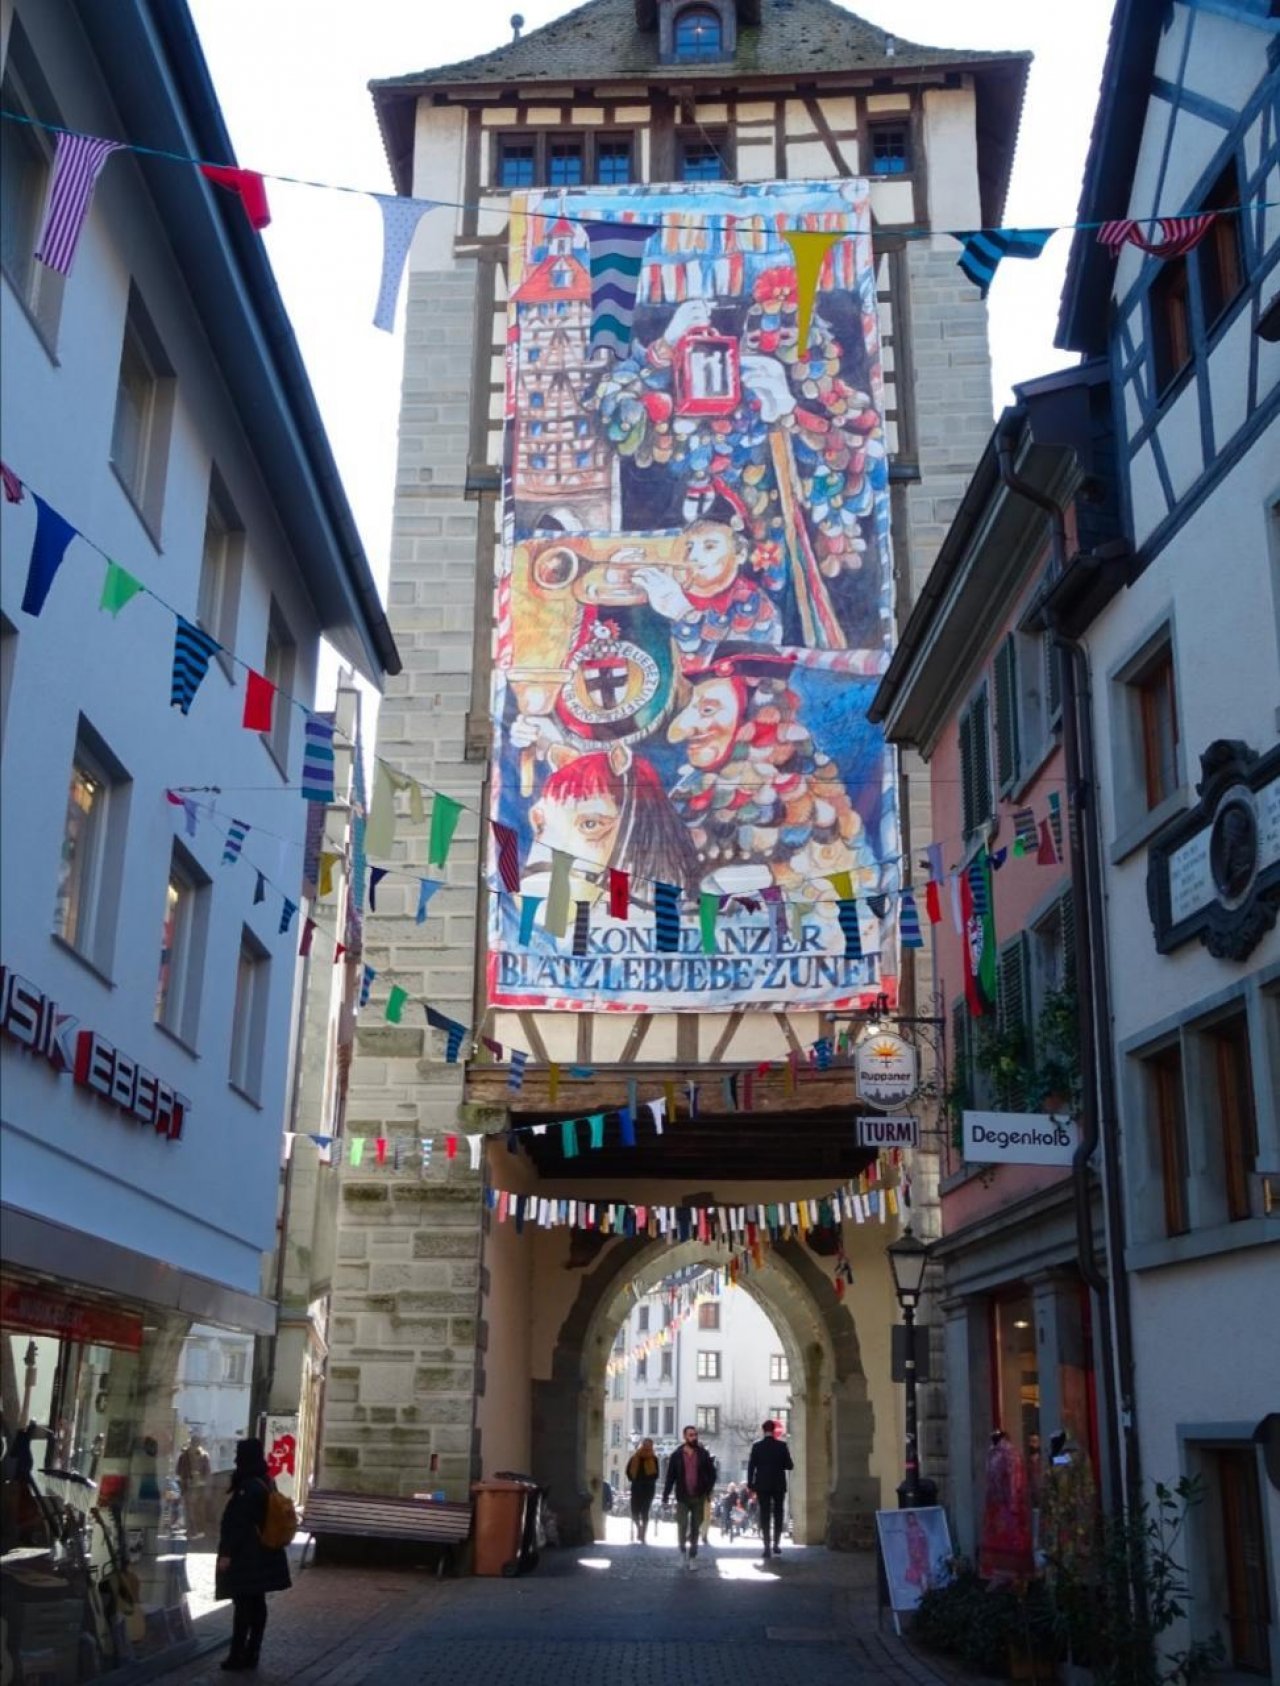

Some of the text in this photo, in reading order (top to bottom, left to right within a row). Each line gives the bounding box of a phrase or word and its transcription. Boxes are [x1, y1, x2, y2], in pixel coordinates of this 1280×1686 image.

[586, 925, 827, 955] KONTNZER
[860, 1071, 912, 1082] Ruppaner
[972, 1125, 1071, 1148] Degenkolb
